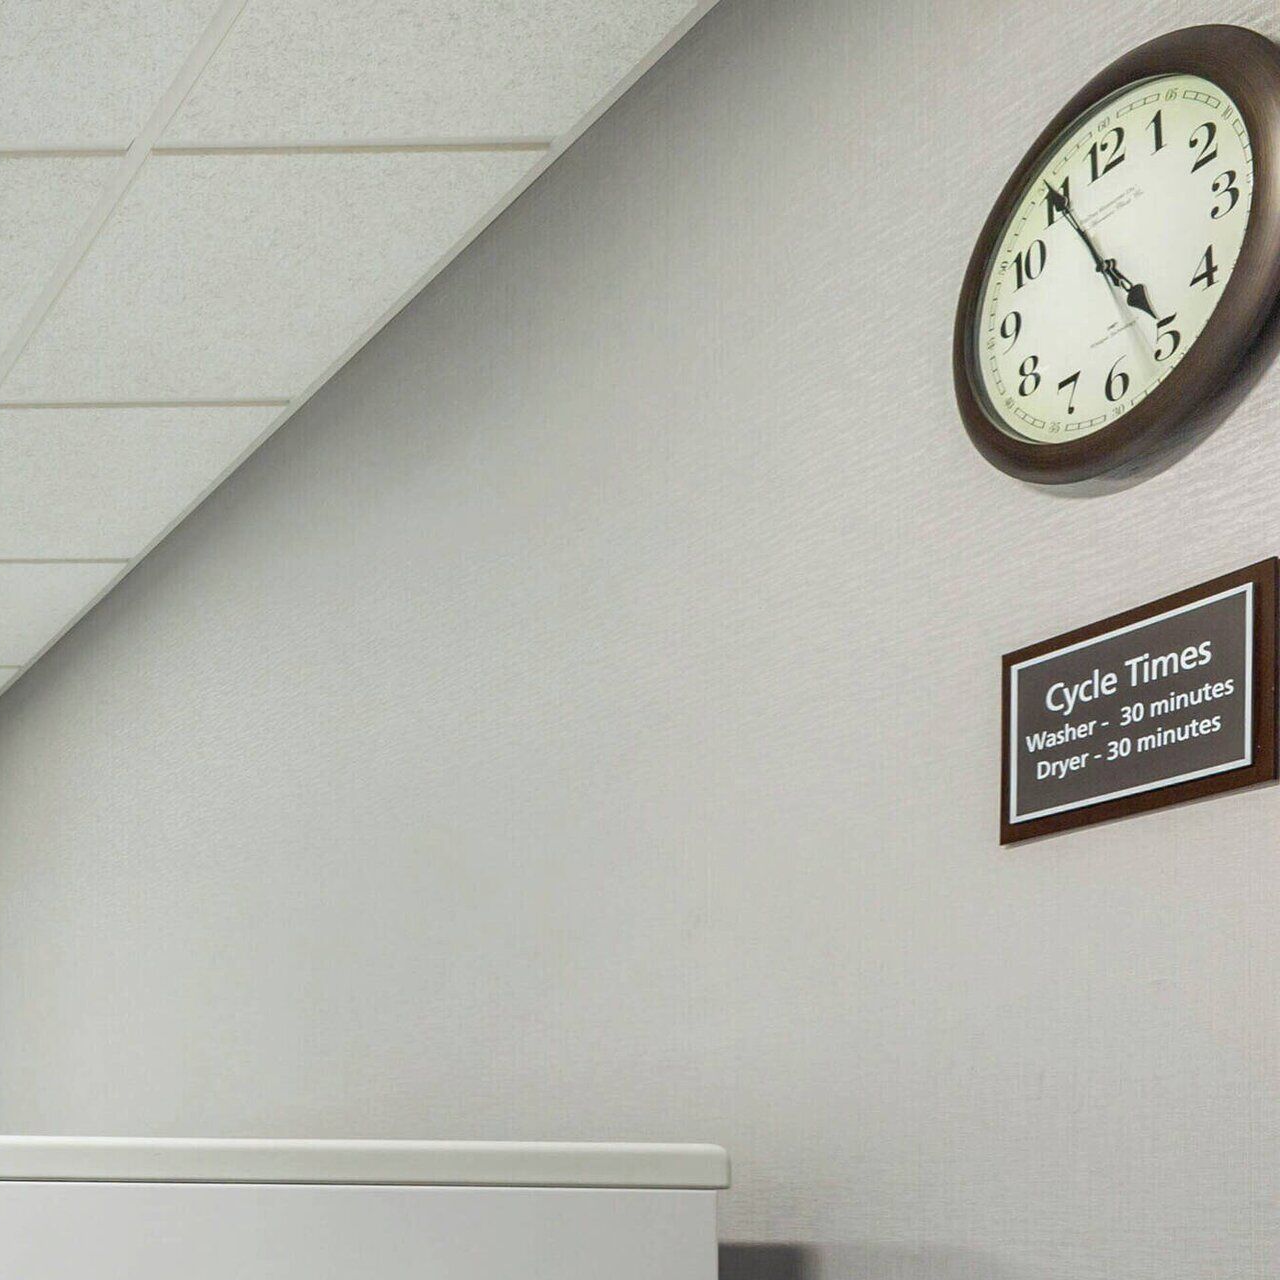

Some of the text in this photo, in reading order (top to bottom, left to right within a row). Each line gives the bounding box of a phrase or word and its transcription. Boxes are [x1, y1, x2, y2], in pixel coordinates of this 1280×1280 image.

[1088, 126, 1126, 184] 12
[1145, 109, 1168, 155] 1
[1189, 121, 1219, 174] 2
[1211, 169, 1240, 220] 3
[1010, 239, 1047, 293] 10
[1188, 244, 1220, 292] 4
[1000, 310, 1022, 355] 9
[1154, 311, 1181, 362] 5
[1017, 354, 1041, 398] 8
[1058, 370, 1081, 414] 7
[1104, 353, 1130, 402] 6
[1044, 640, 1213, 716] Cycle Times
[1025, 719, 1097, 753] Washer
[1120, 702, 1145, 727] 30
[1150, 677, 1235, 718] minutes
[1036, 751, 1090, 780] Dryer
[1106, 737, 1132, 762] 30
[1137, 713, 1222, 752] minutes
